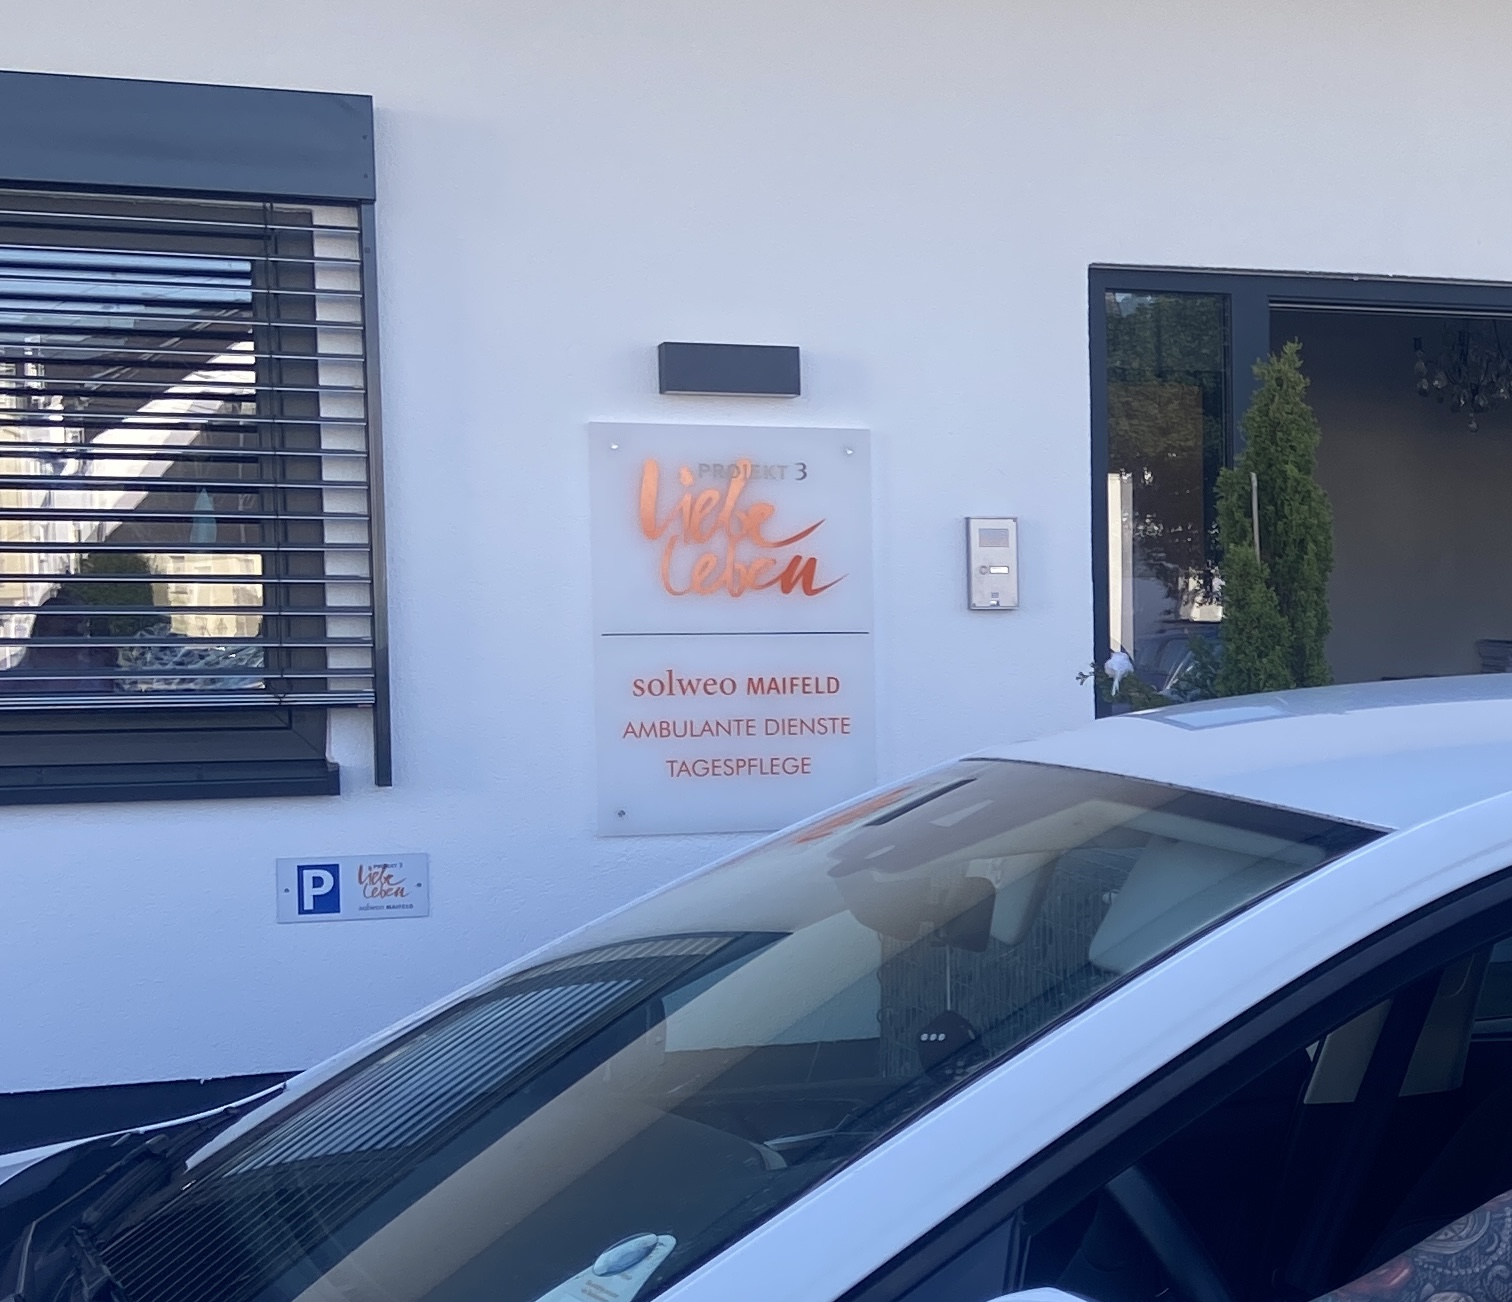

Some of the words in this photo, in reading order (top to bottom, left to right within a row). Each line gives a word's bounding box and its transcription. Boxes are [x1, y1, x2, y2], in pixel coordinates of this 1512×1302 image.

[699, 462, 789, 481] PROJEKT
[795, 461, 808, 481] 3
[639, 457, 826, 549] Liebe
[661, 535, 850, 598] Leben
[632, 669, 737, 697] solweo
[746, 676, 841, 696] MAIFELD
[622, 719, 757, 739] AMBULANTE
[764, 717, 851, 736] DIENSTE
[666, 756, 811, 778] TAGESPFLEGE
[302, 868, 335, 911] P
